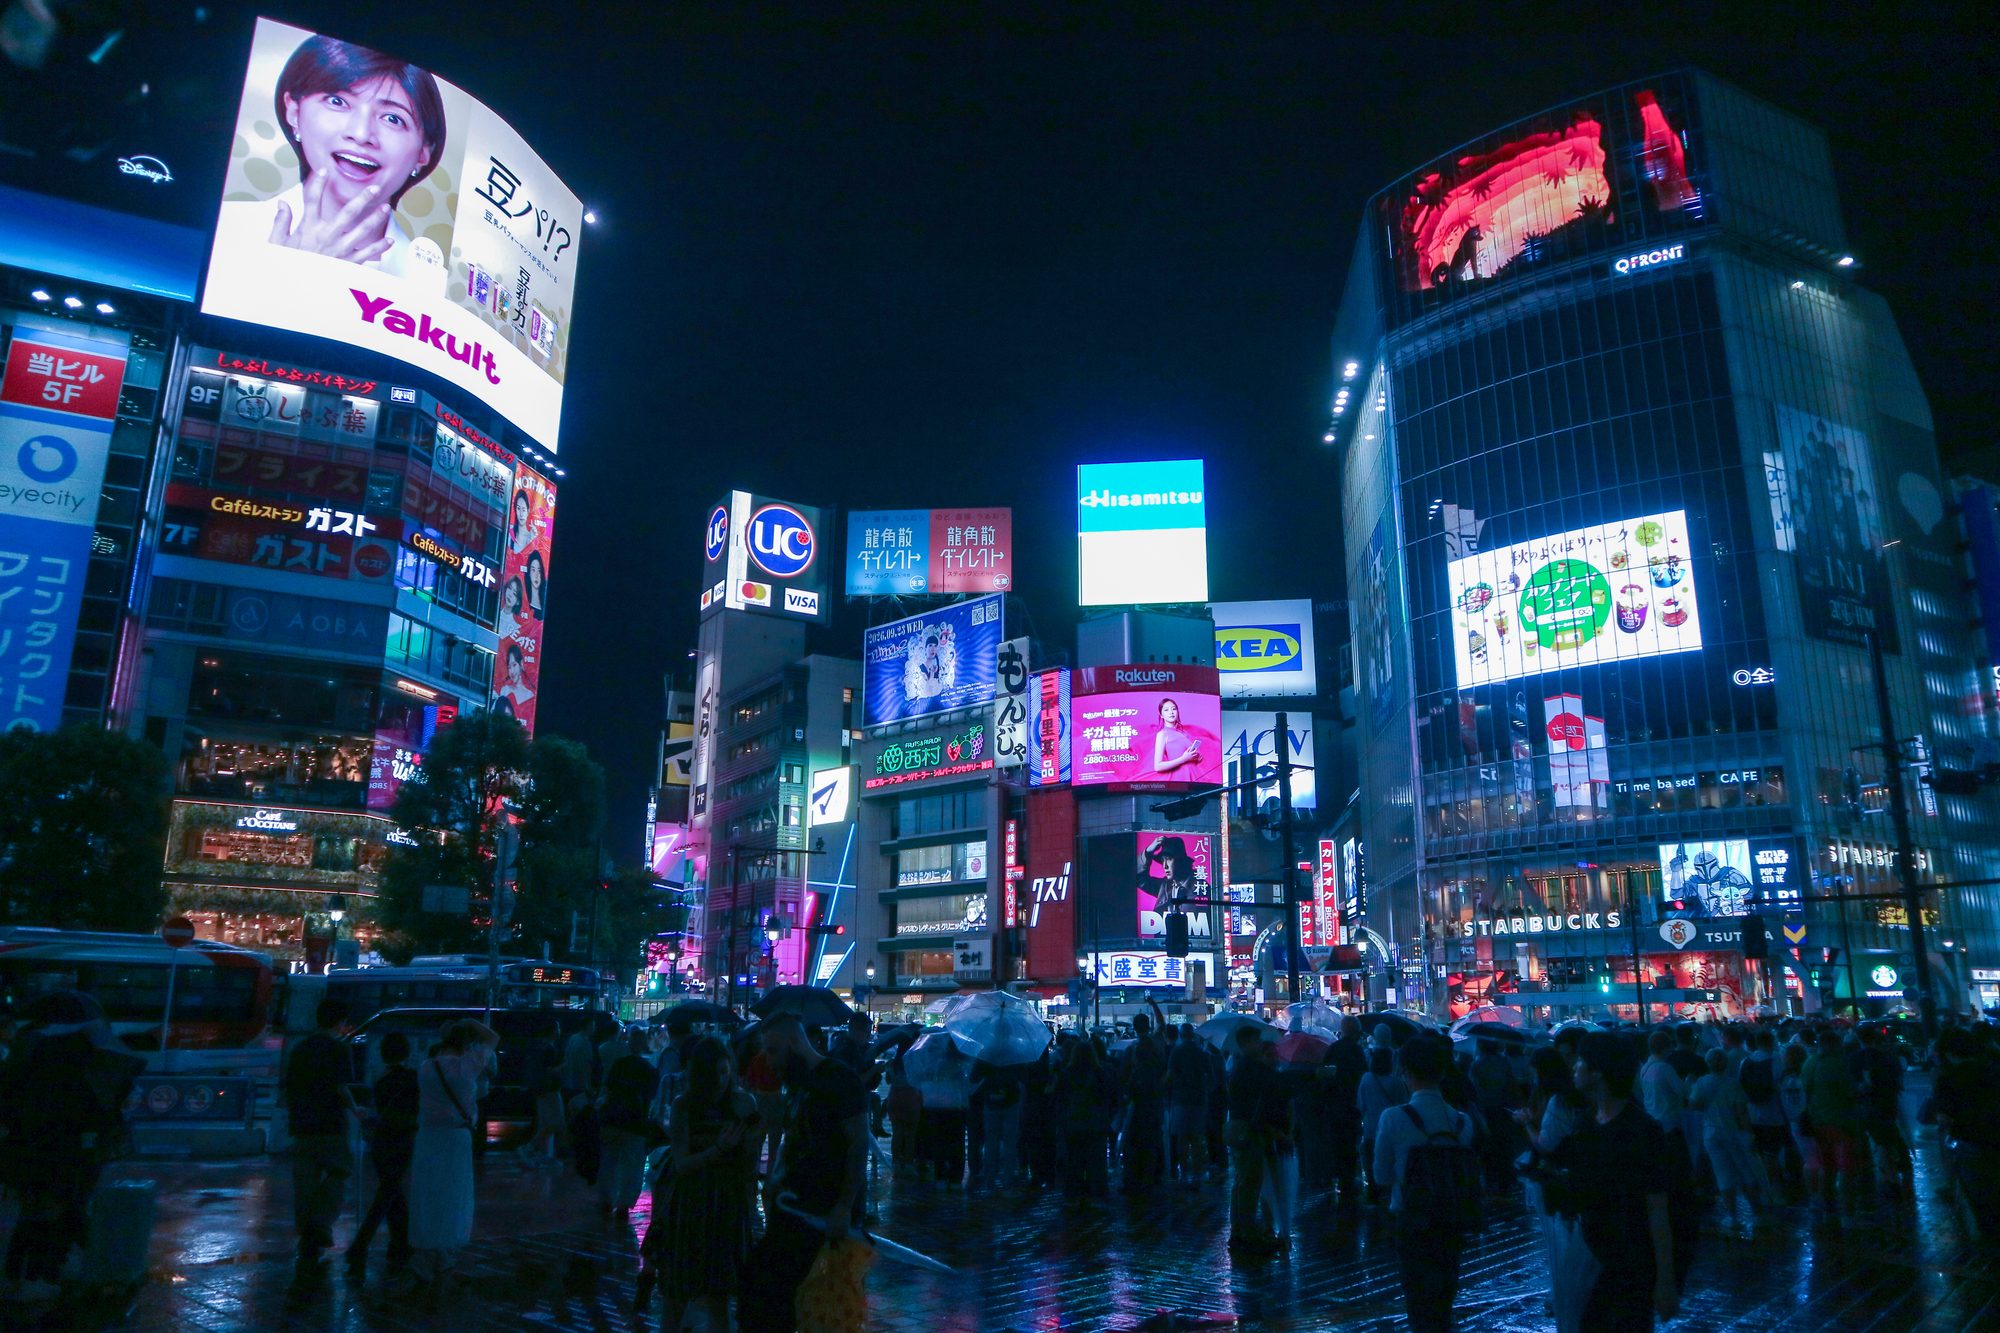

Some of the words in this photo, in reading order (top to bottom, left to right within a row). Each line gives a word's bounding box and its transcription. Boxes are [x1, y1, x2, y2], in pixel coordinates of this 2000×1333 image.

[1616, 245, 1683, 274] QFRONT
[349, 288, 500, 385] Yakult
[27, 352, 104, 384] 当ビル
[217, 352, 377, 395] しゃぶしゃぶバイキング
[41, 381, 84, 404] 5F
[190, 385, 219, 404] 9F
[278, 396, 367, 434] しゃぶ葉
[1080, 488, 1202, 508] Hisamitsu
[164, 523, 199, 544] 7F
[305, 506, 377, 538] ガスト
[865, 527, 913, 548] 龍角散
[947, 525, 996, 546] 龍角散
[251, 532, 341, 573] ガスト
[857, 549, 922, 570] ダイレクト
[940, 548, 1005, 568] ダイレクト
[460, 556, 496, 588] ガスト
[787, 594, 817, 609] VISA
[1215, 638, 1292, 658] KEA
[1115, 668, 1175, 684] Rakuten
[997, 642, 1027, 762] もんじゃ
[905, 745, 941, 769] 西村
[1193, 839, 1208, 895] 八つ墓村
[1828, 845, 1927, 870] STARBS
[1322, 848, 1334, 901] カラオケ
[1464, 912, 1621, 936] STARBUCKS
[1705, 931, 1773, 942] TSUTA
